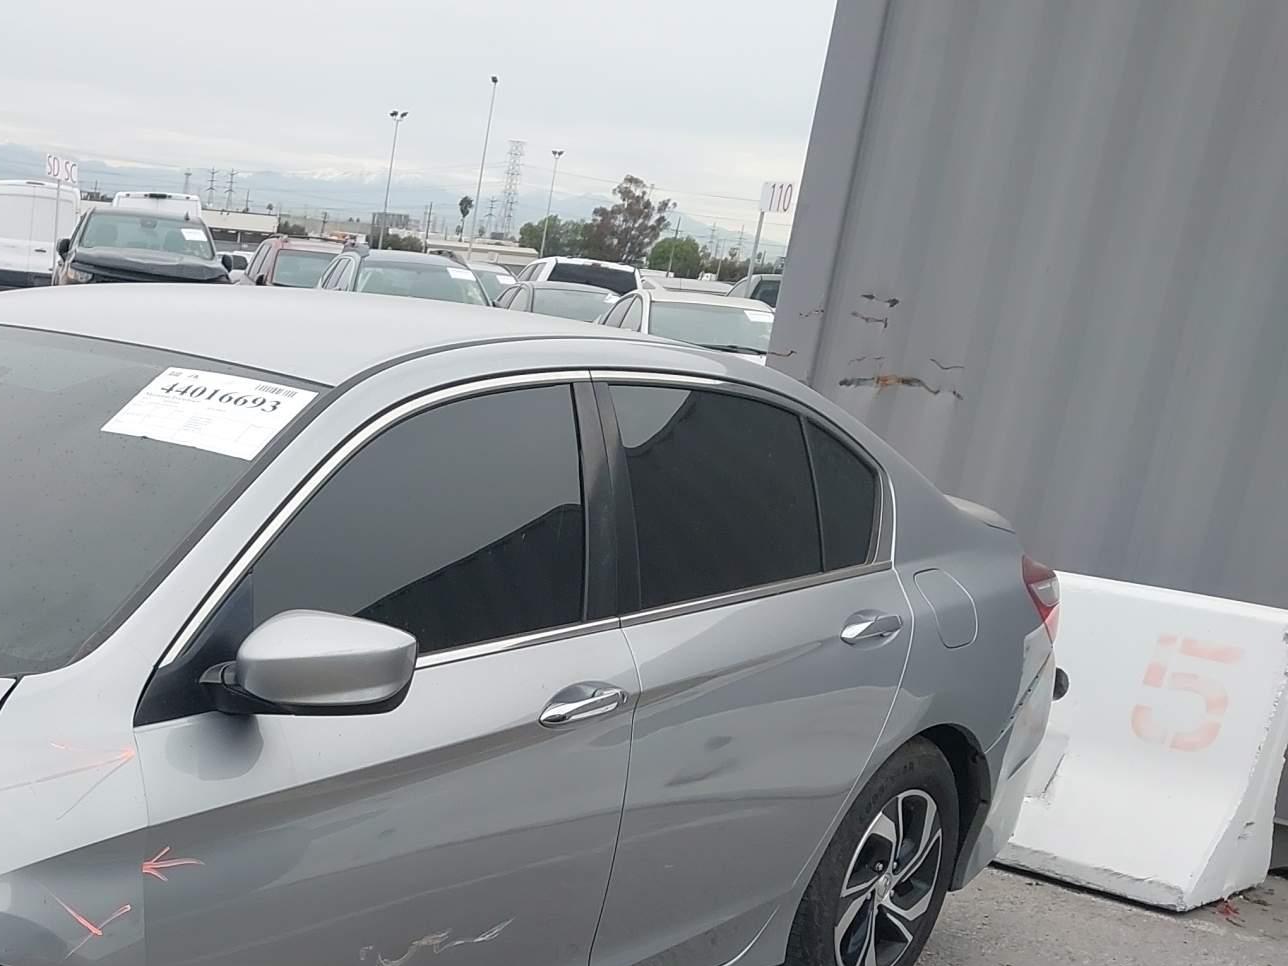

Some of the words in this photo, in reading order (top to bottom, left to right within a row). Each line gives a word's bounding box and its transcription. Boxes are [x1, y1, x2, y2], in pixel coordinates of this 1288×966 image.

[47, 154, 60, 177] SD
[64, 160, 77, 184] SC
[768, 183, 793, 212] 110
[160, 382, 281, 413] 44016693
